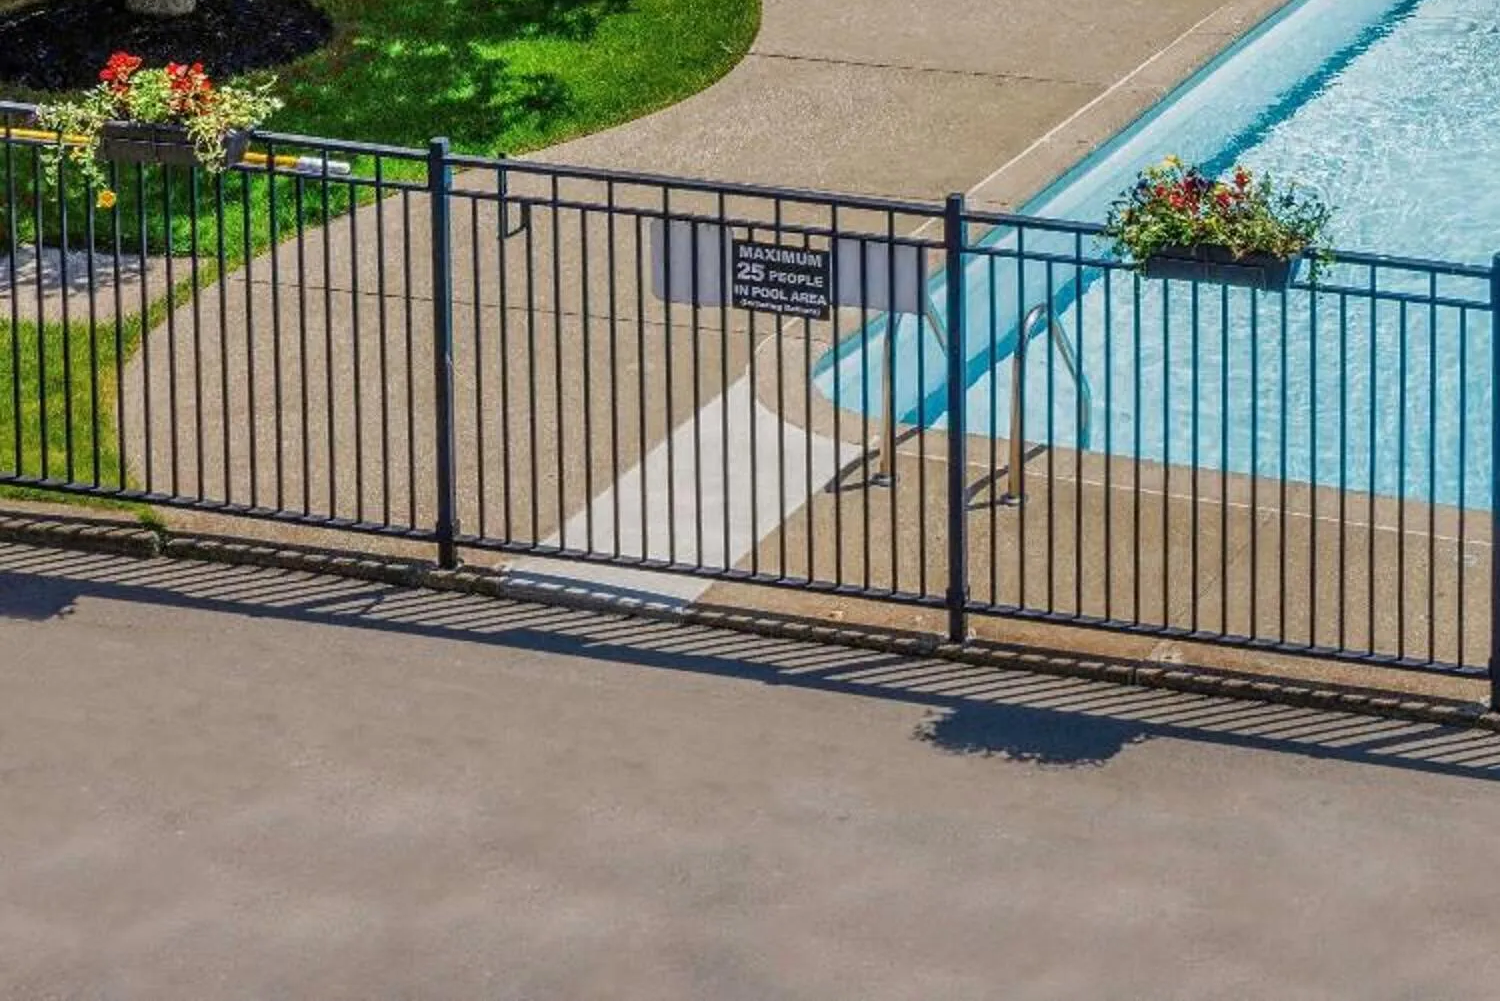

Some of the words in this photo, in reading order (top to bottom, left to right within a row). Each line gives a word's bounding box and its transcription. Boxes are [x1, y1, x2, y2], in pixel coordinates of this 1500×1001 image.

[739, 245, 822, 268] MAXIMUM
[737, 261, 765, 282] 25
[769, 270, 824, 288] PEOPLE
[734, 284, 749, 296] IN
[751, 286, 789, 301] POOL
[790, 291, 828, 306] AREA
